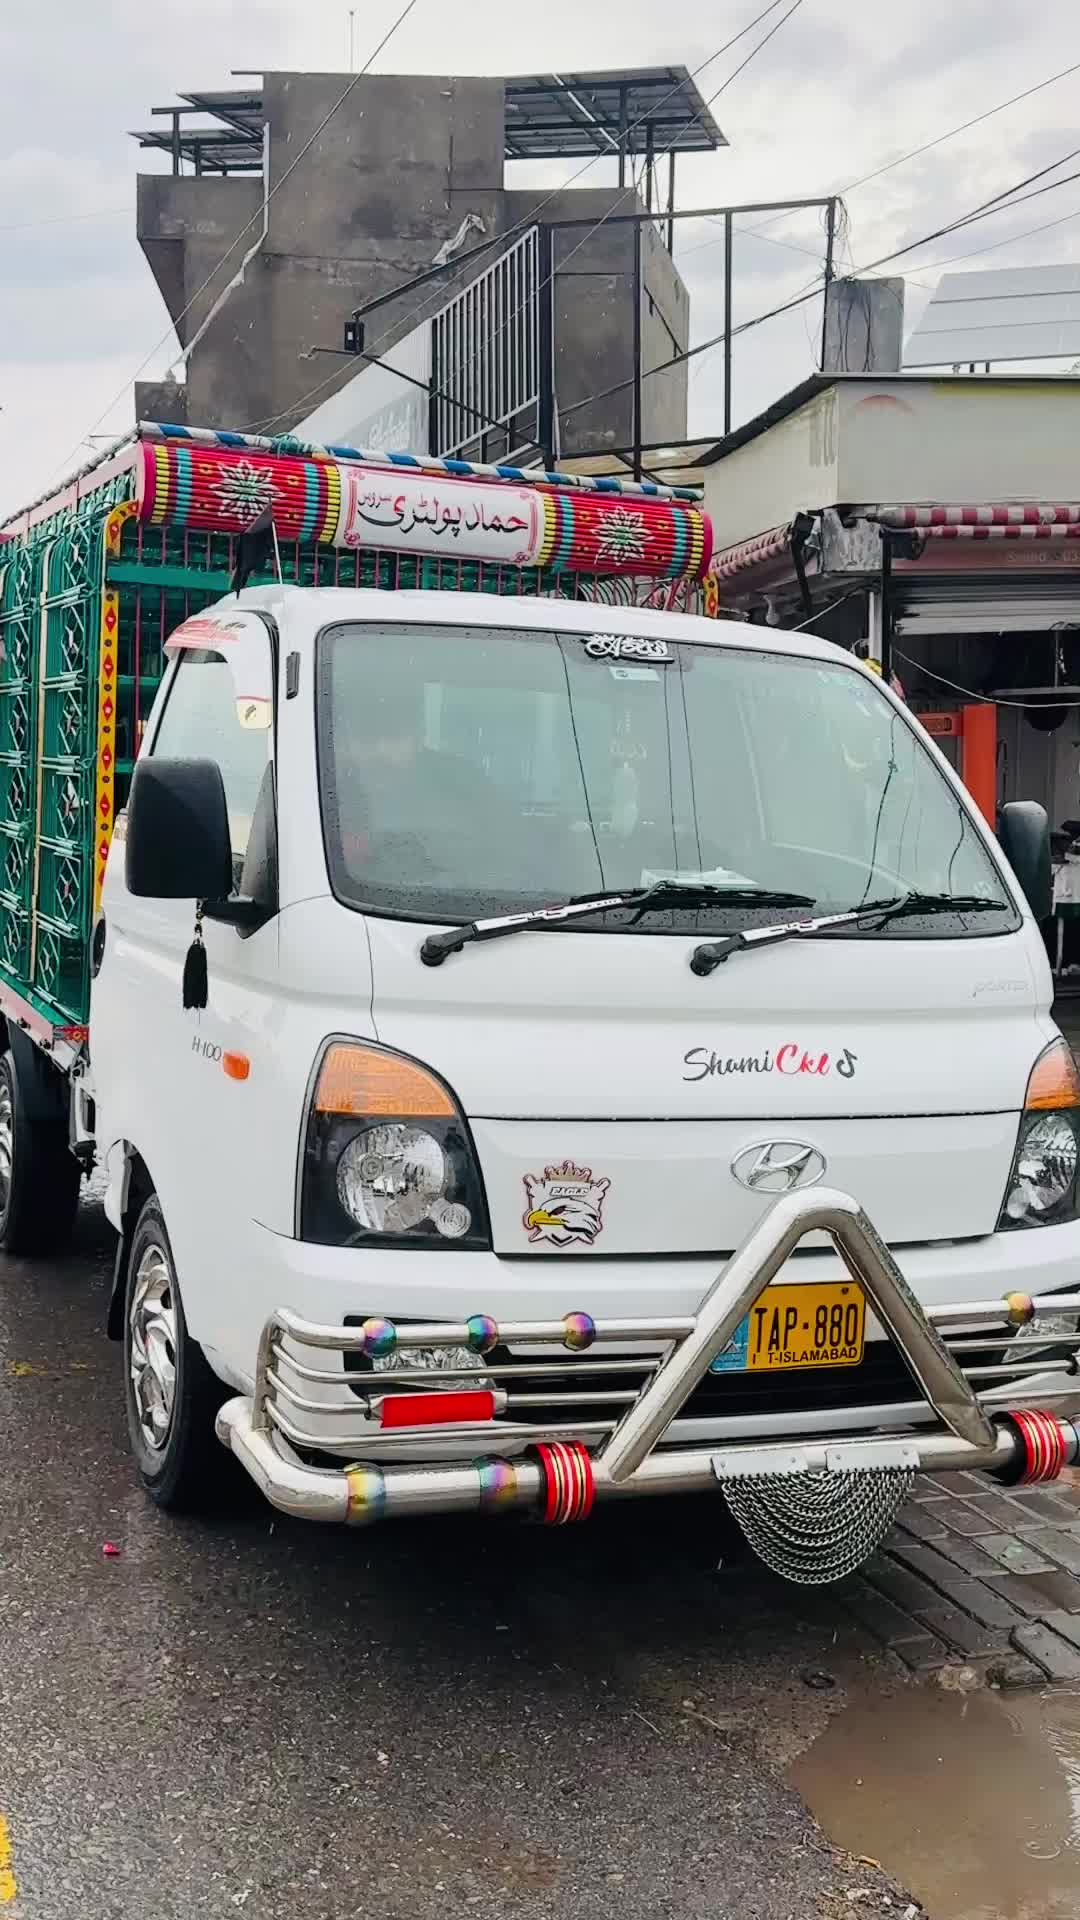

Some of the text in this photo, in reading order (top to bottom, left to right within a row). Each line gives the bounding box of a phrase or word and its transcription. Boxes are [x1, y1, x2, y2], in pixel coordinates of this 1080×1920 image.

[357, 492, 463, 538] پولٹری
[682, 1046, 774, 1081] Shami
[549, 1186, 589, 1198] EAGLE
